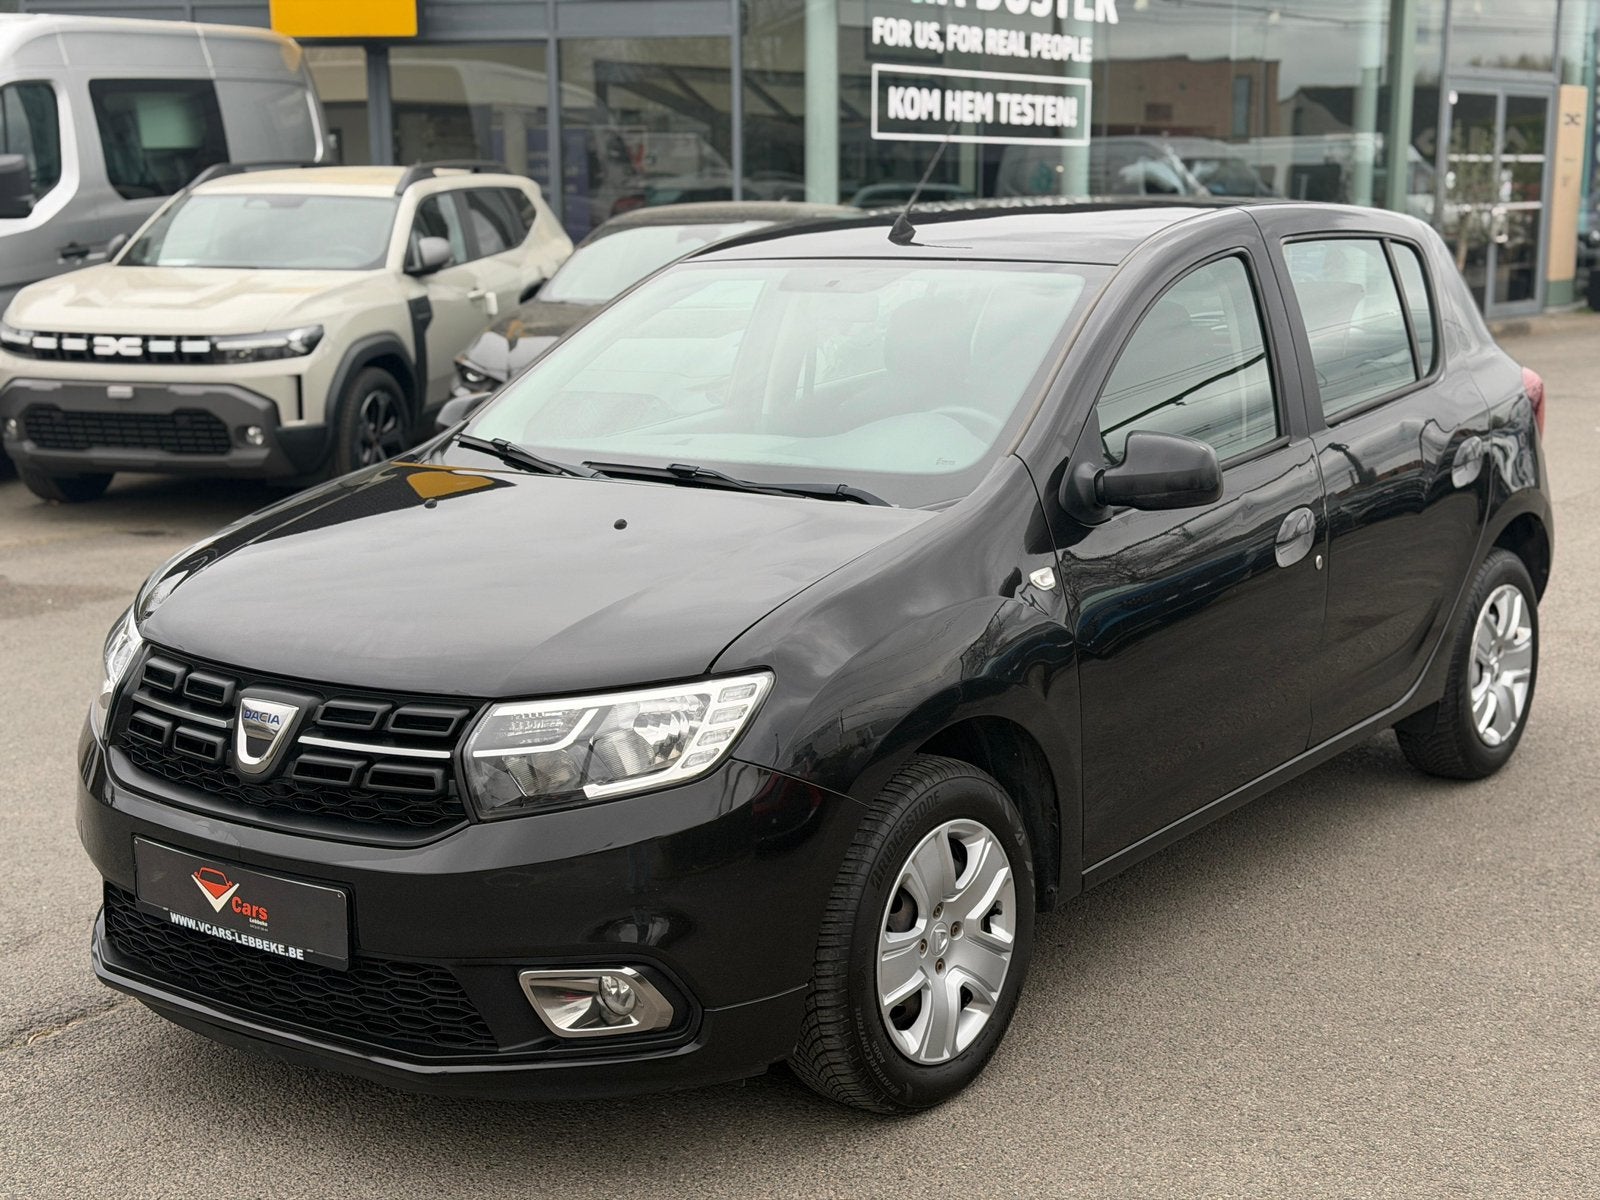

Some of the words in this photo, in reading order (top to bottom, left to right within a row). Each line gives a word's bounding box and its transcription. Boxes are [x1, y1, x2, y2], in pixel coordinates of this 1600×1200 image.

[872, 16, 912, 47] FOR
[914, 20, 944, 53] US,
[947, 24, 984, 54] FOR
[985, 28, 1029, 58] REAL
[1030, 32, 1093, 63] PEOPLE
[888, 85, 942, 121] KOM
[945, 89, 994, 123] HEM
[996, 92, 1078, 128] TESTEN!
[244, 709, 280, 725] DACIA
[231, 896, 268, 921] Cars
[169, 912, 305, 961] WWW.VCARS-LEBBEKE.BE
